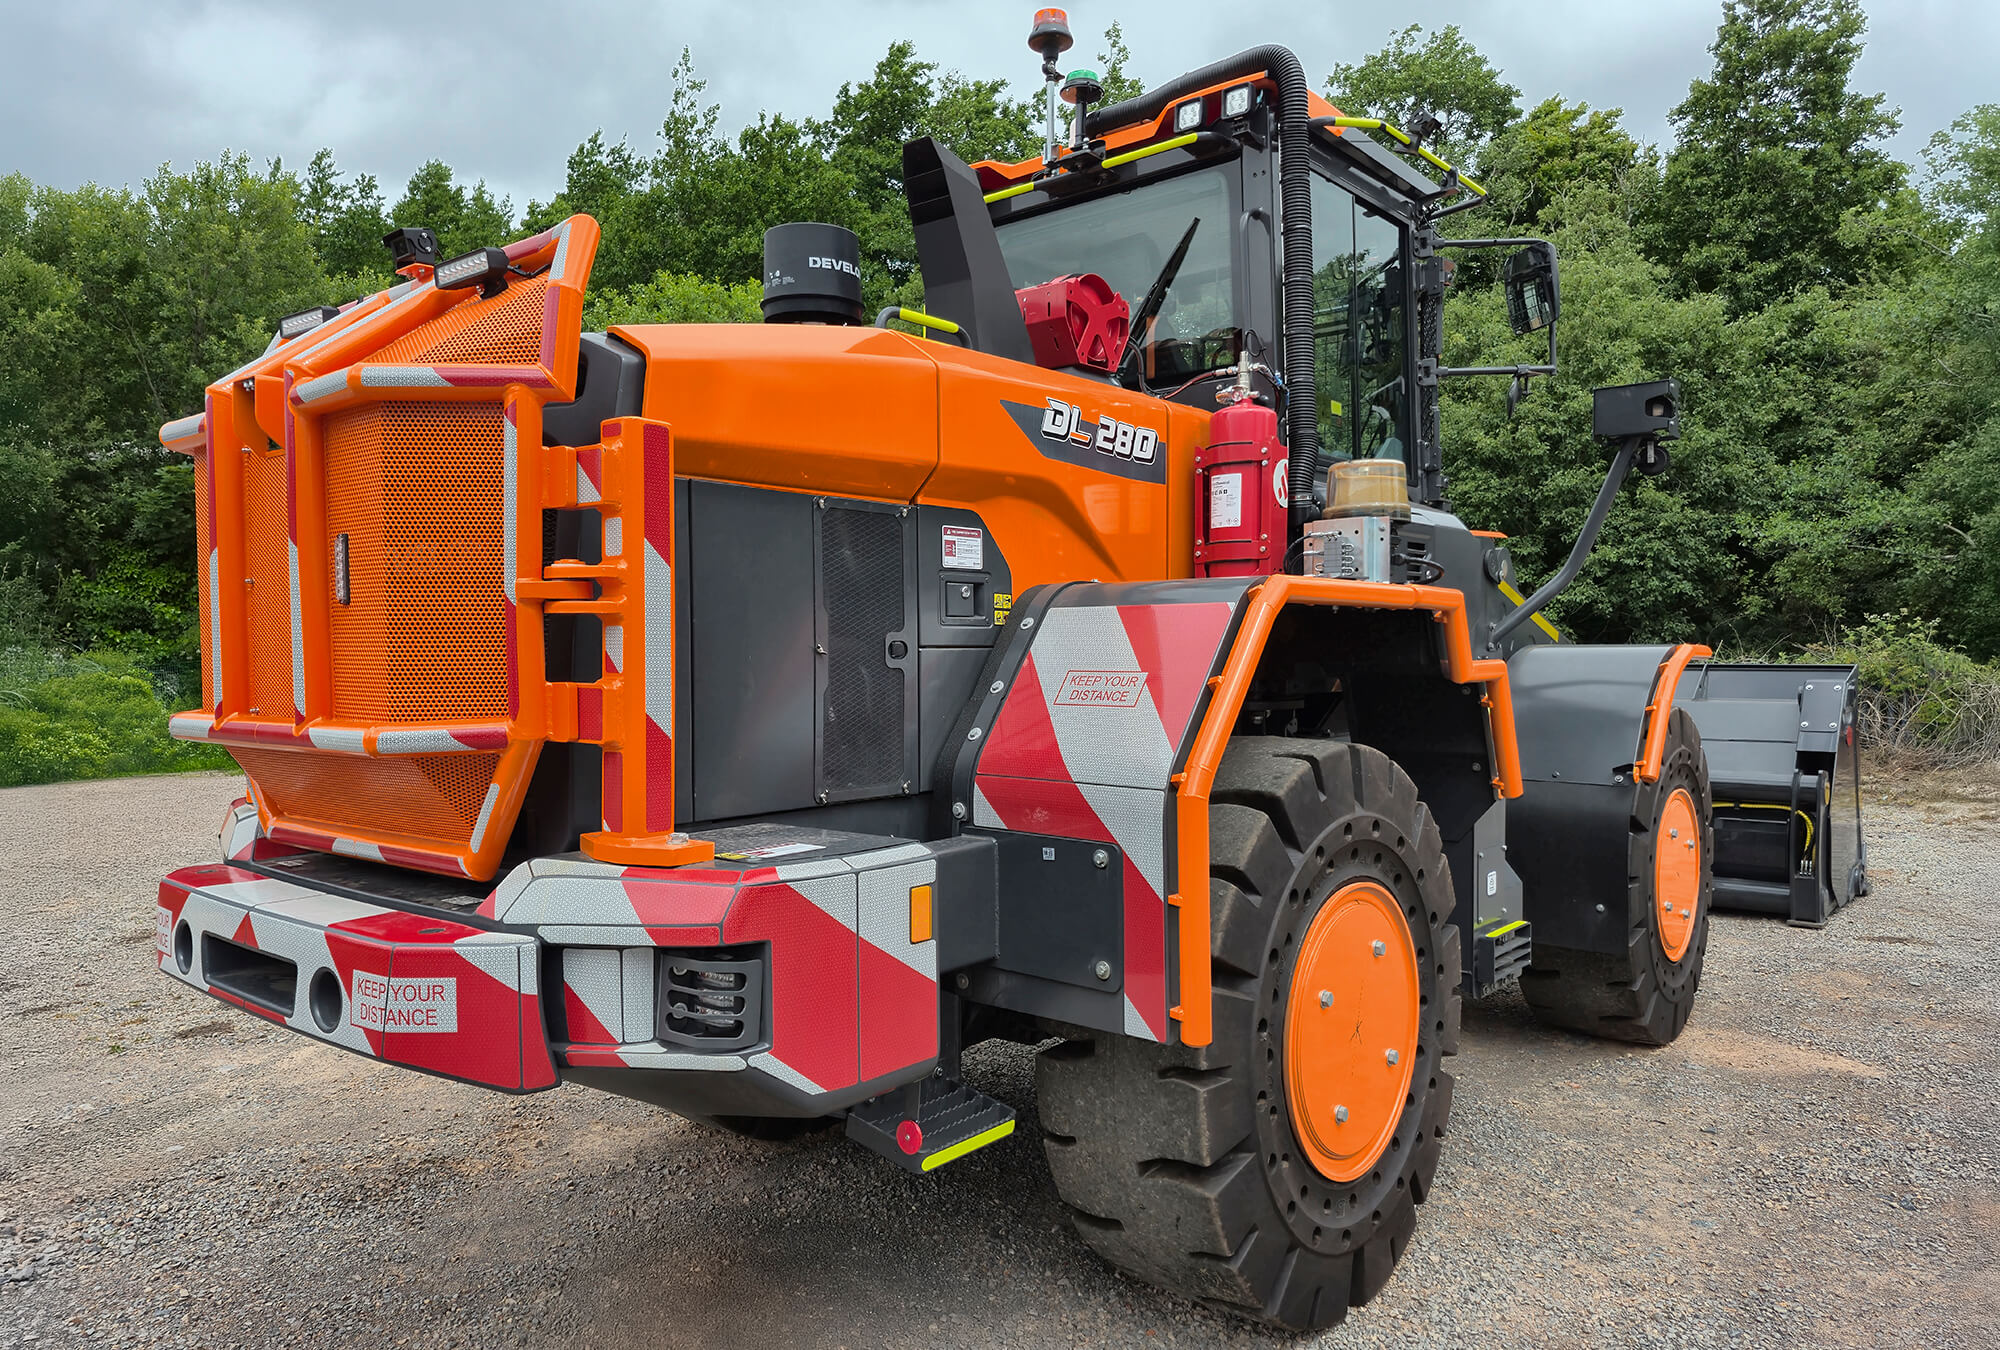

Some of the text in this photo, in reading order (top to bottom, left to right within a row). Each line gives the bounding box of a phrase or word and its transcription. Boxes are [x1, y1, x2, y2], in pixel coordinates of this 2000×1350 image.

[1041, 396, 1159, 465] DL 280
[1069, 675, 1139, 687] KEEP YOUR
[1069, 689, 1130, 702] DISTANCE
[357, 977, 446, 1002] KEEP YOUR
[360, 1002, 438, 1027] DISTANCE
